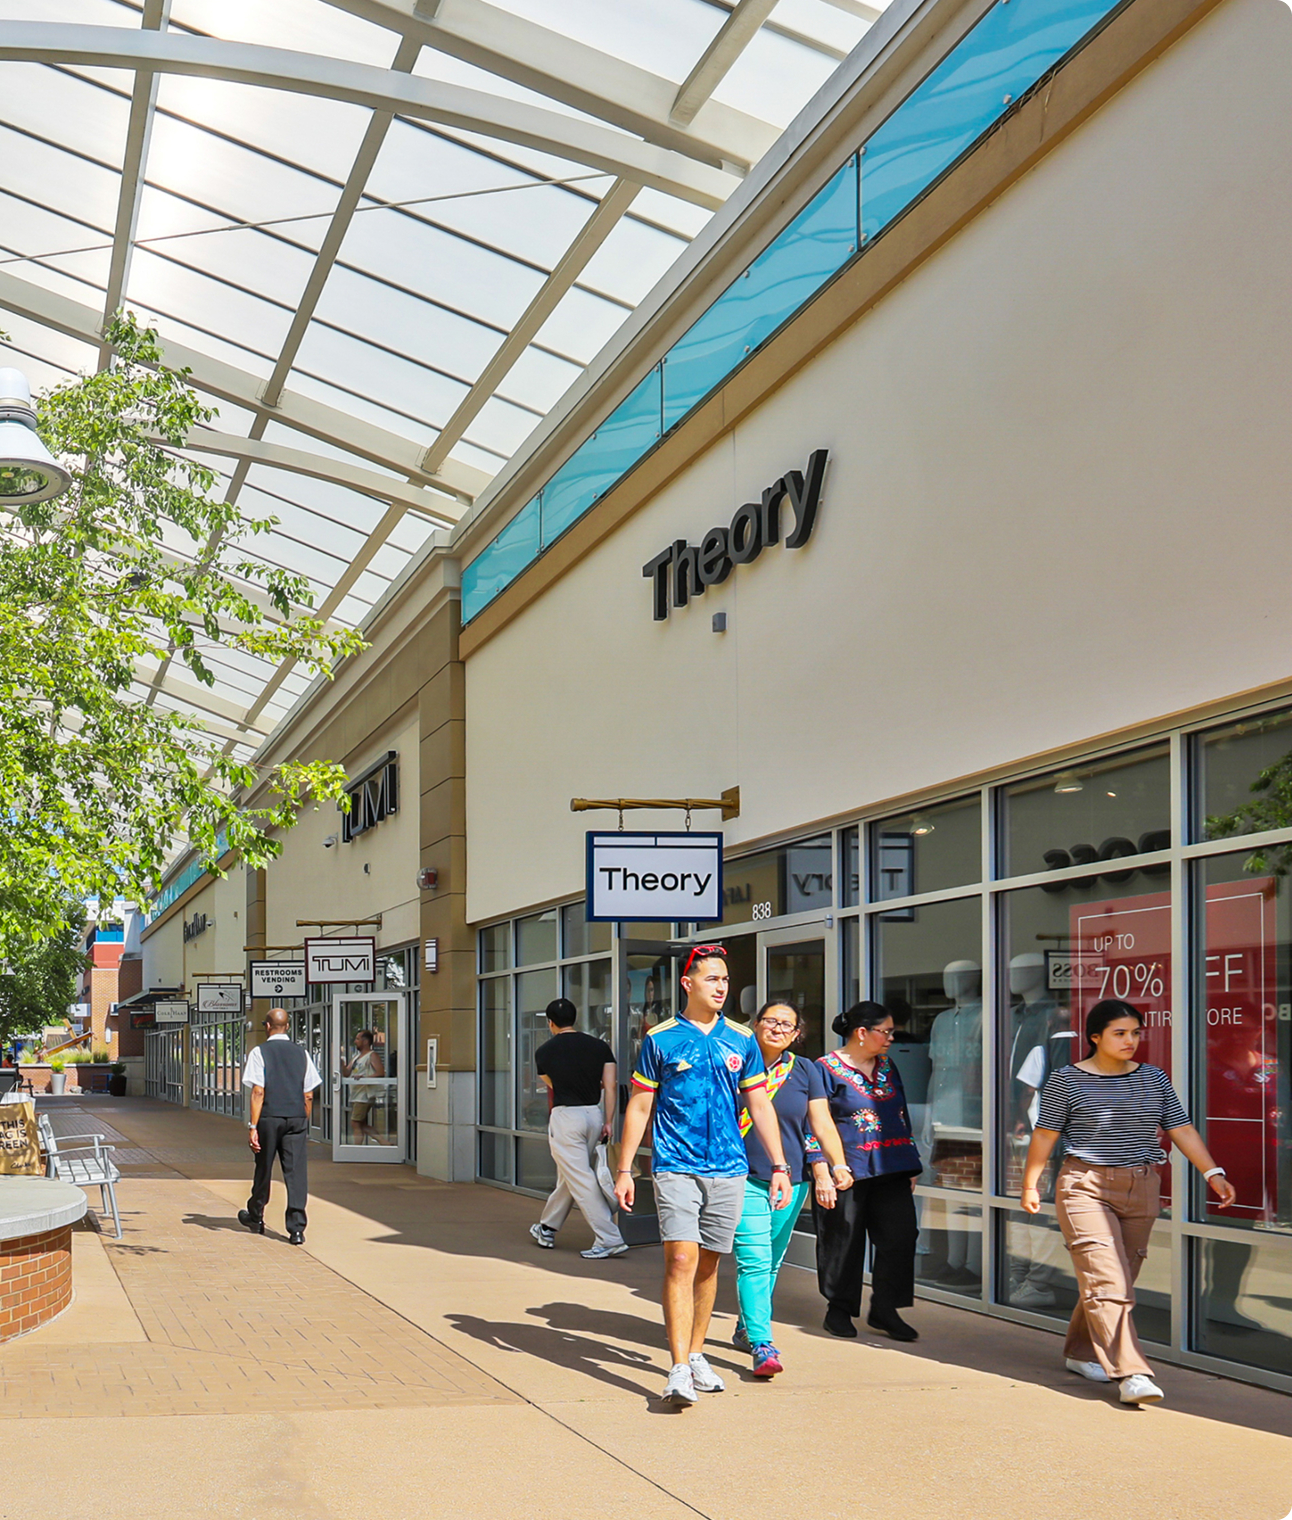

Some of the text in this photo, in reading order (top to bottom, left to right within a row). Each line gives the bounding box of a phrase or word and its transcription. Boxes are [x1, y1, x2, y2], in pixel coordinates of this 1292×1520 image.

[642, 448, 829, 621] Theory
[336, 750, 397, 843] TUMI
[599, 868, 713, 896] Theory
[752, 902, 771, 920] 838
[1094, 933, 1135, 952] UP TO
[312, 955, 369, 972] TUMI
[1095, 953, 1243, 999] 70% FF
[1142, 1006, 1243, 1028] NTIR ORE
[0, 1119, 25, 1130] THIS
[16, 1129, 27, 1139] IS
